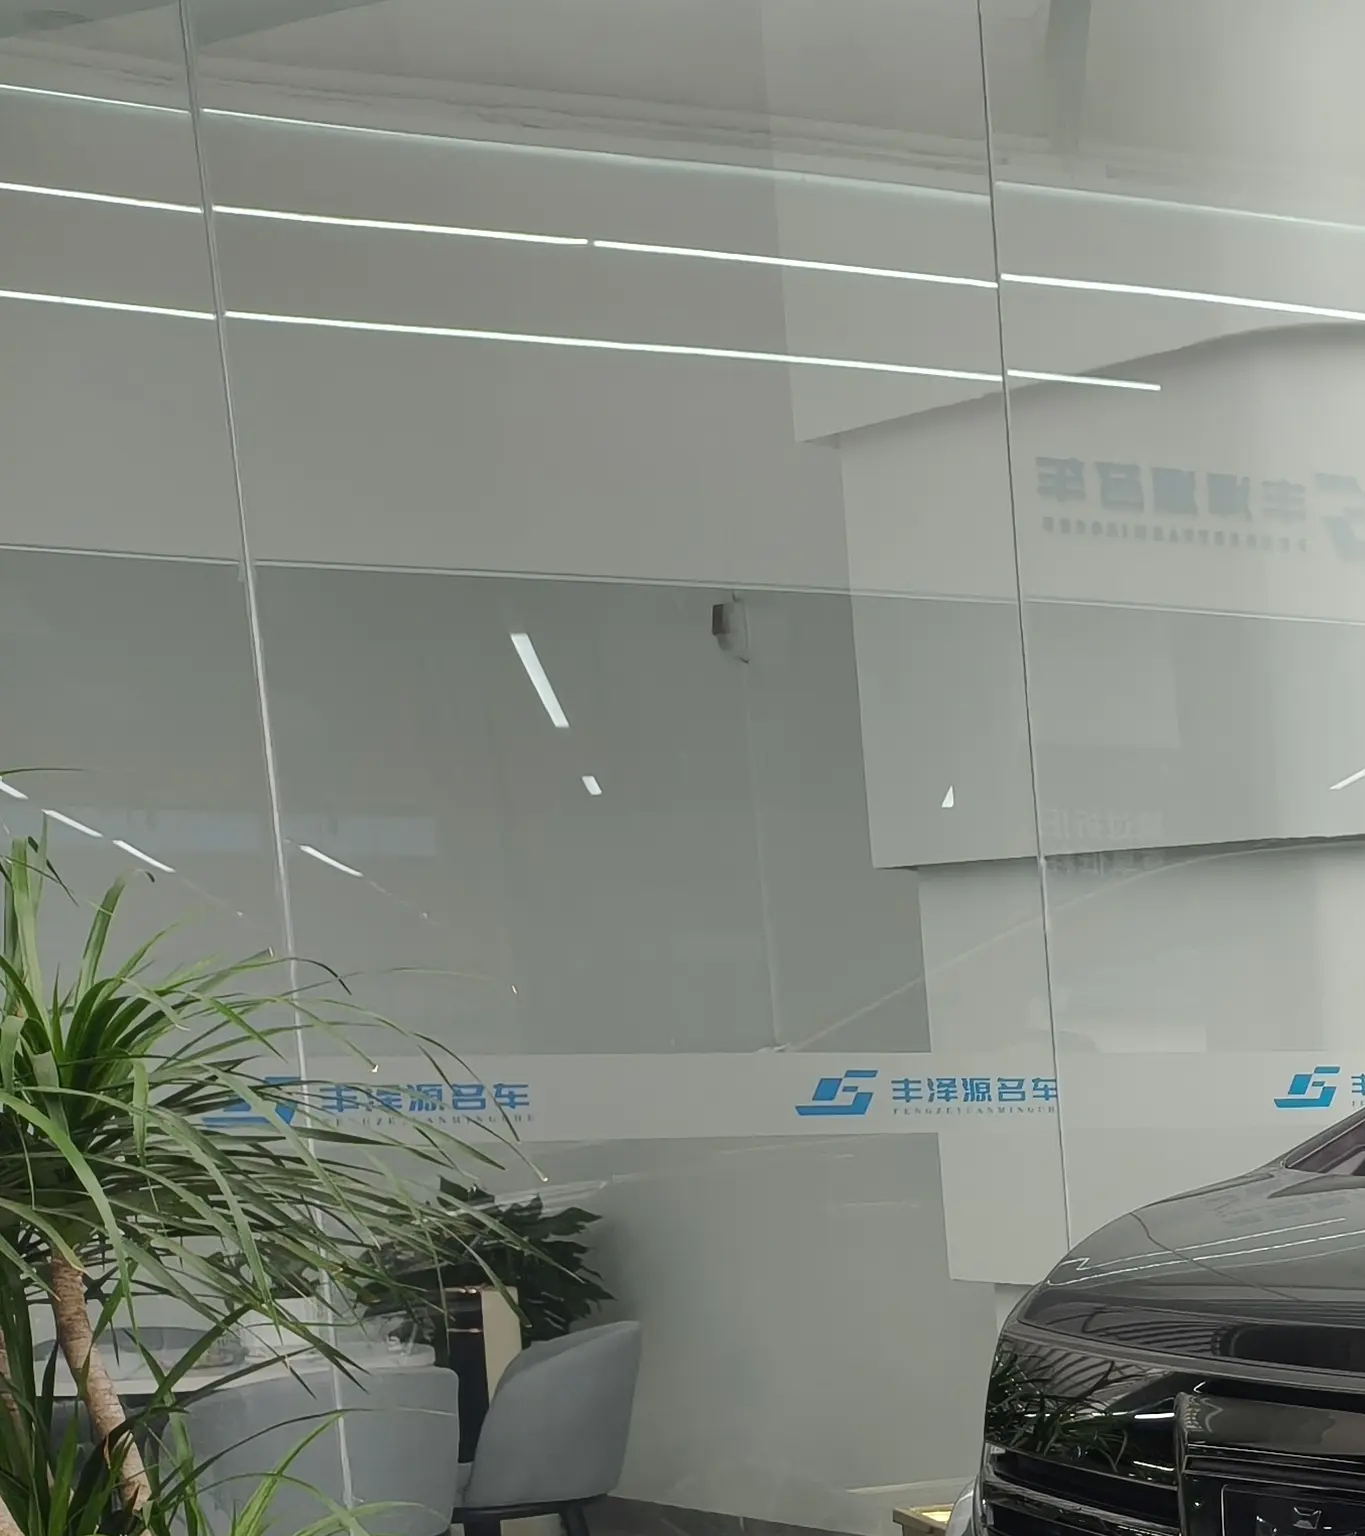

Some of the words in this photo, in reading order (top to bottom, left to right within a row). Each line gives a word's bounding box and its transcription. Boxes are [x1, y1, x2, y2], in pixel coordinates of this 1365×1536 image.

[891, 1077, 1058, 1103] 丰泽源名车
